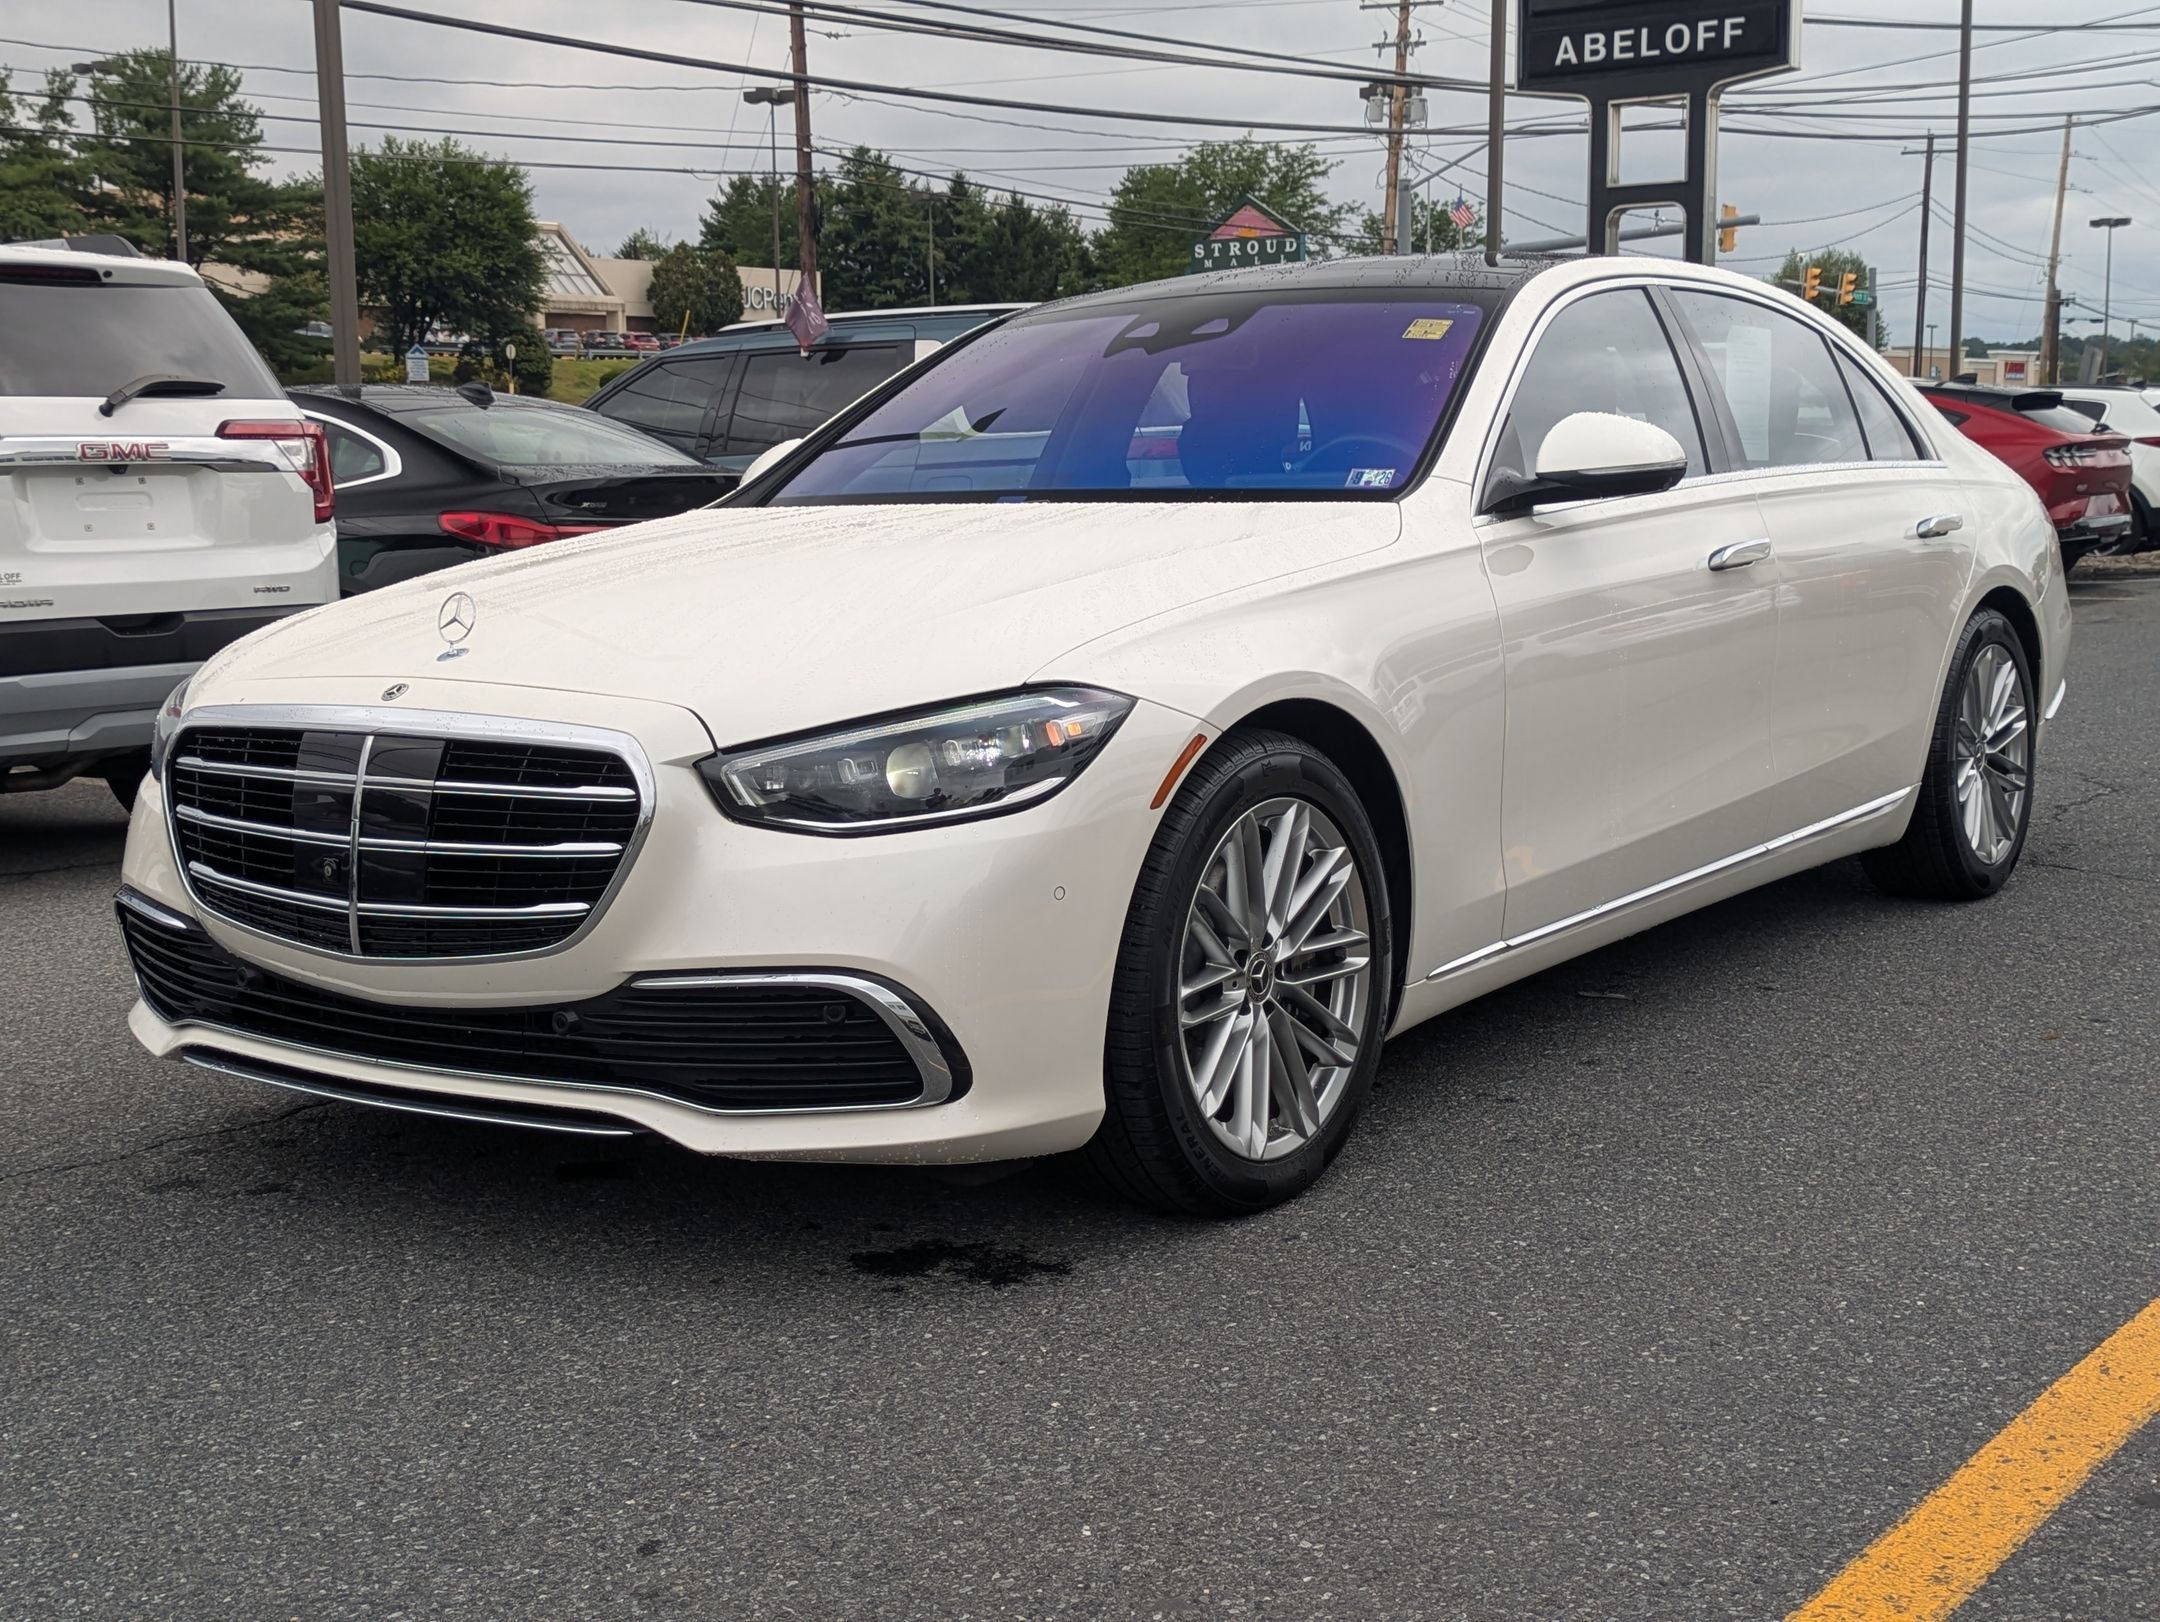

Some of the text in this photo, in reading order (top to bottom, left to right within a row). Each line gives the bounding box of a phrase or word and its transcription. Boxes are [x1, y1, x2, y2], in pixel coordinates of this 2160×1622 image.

[1554, 16, 1746, 67] ABELOFF
[1194, 238, 1298, 259] STROUD
[1203, 254, 1288, 269] MALL
[78, 441, 171, 461] GMC
[1175, 1106, 1233, 1186] GENERAL
